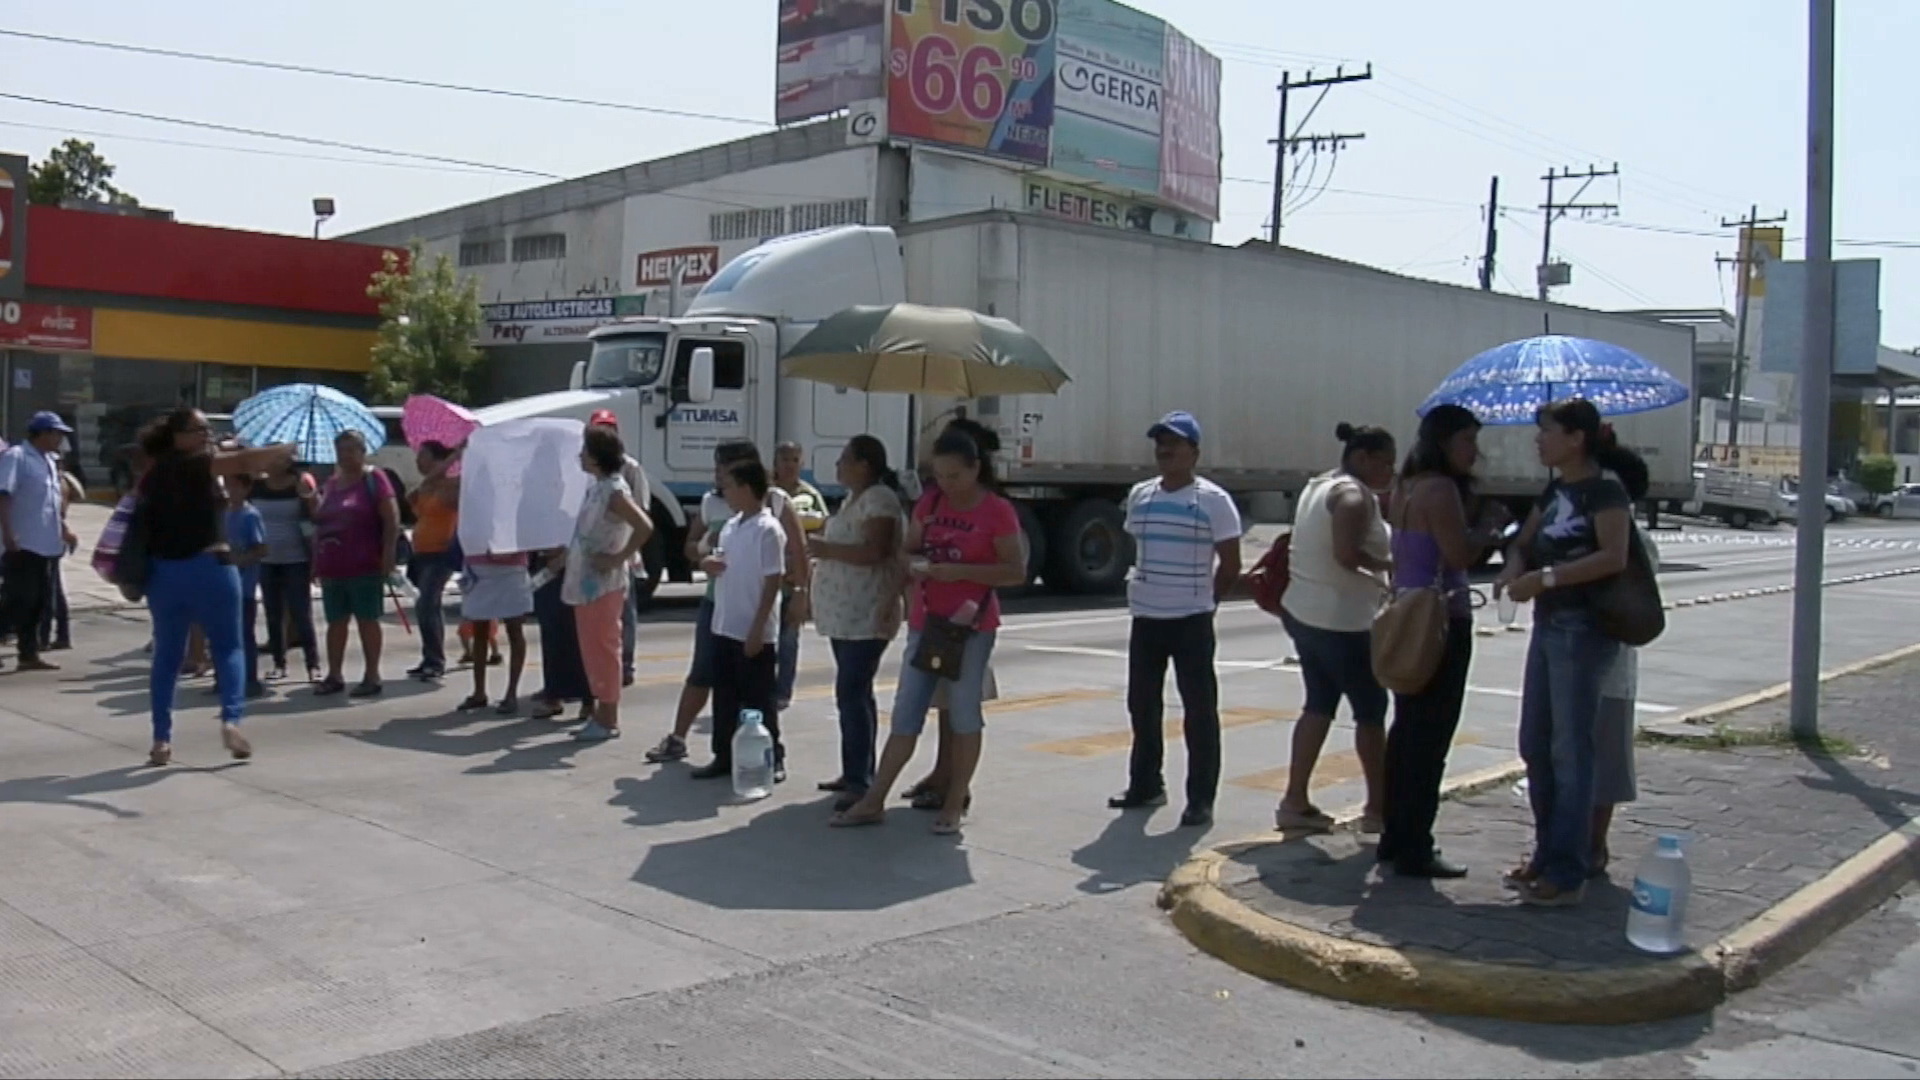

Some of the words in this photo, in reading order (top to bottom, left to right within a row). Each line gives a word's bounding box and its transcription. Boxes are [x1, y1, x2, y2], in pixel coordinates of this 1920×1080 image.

[898, 0, 1053, 41] SO
[1091, 73, 1159, 113] GERSA
[1029, 184, 1118, 224] FLETES
[682, 409, 738, 422] TUMSA
